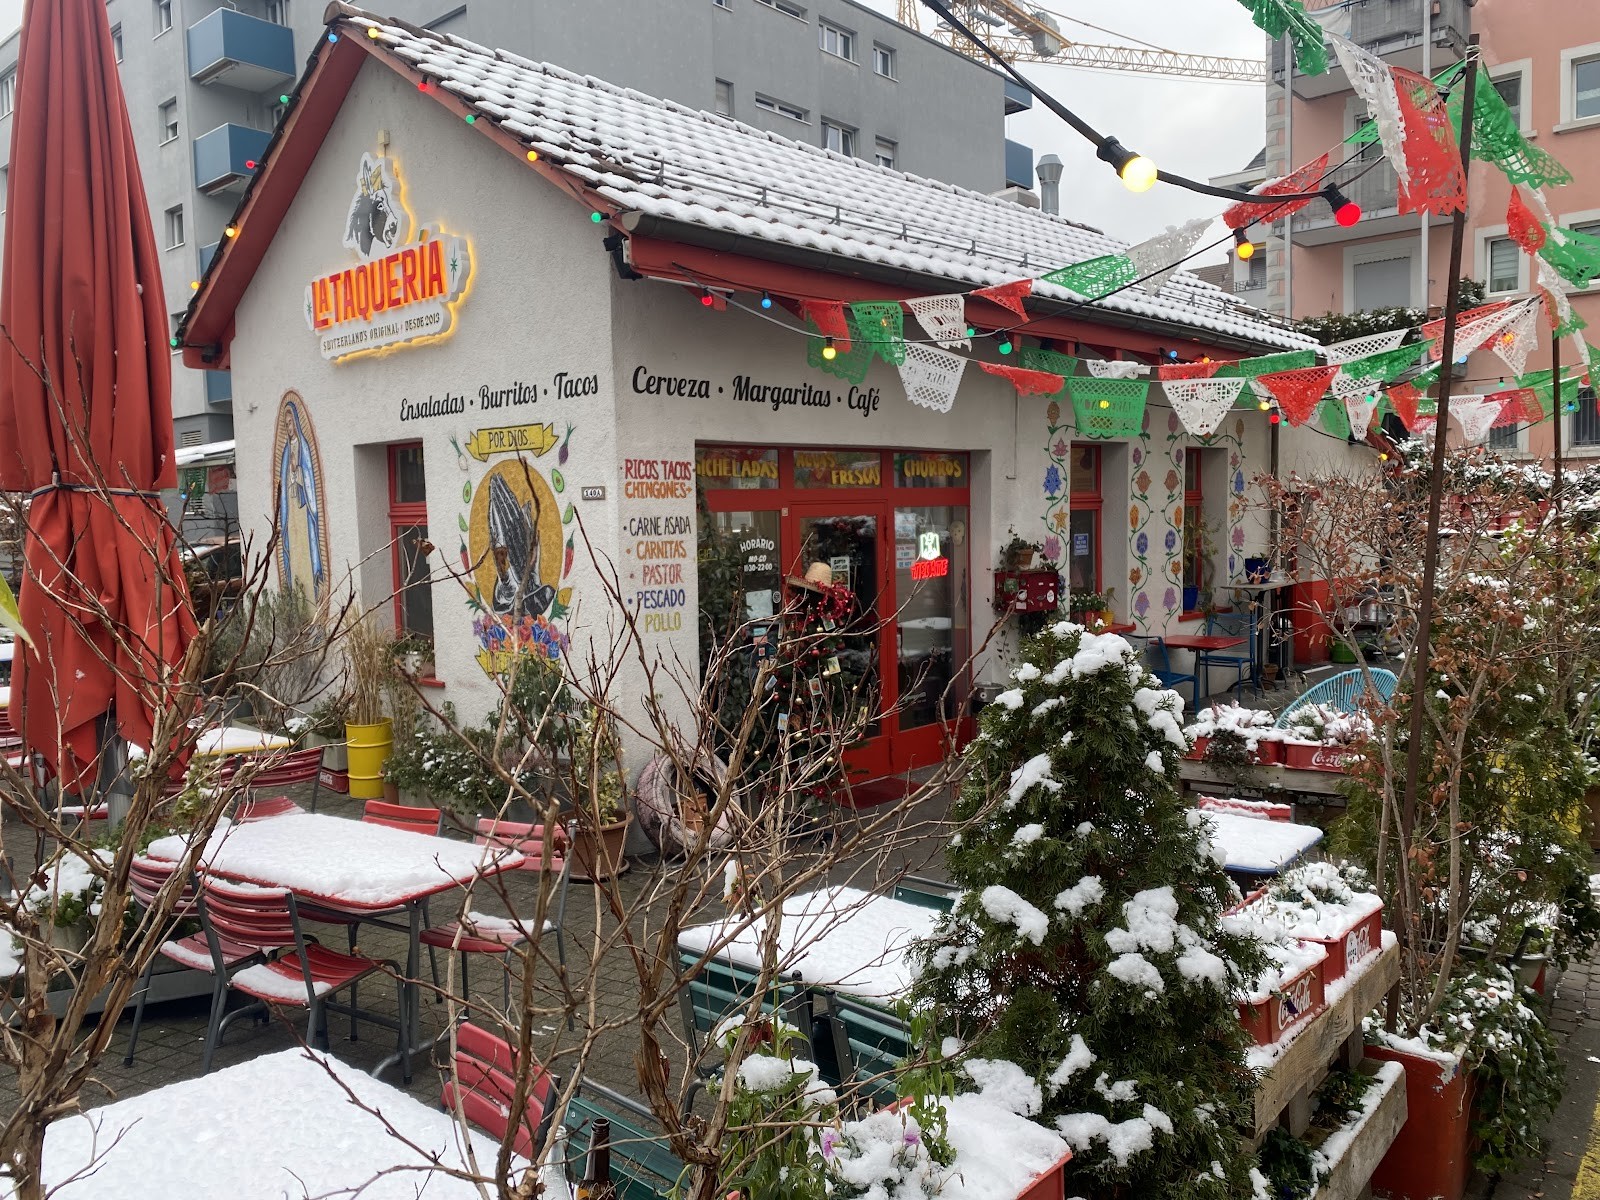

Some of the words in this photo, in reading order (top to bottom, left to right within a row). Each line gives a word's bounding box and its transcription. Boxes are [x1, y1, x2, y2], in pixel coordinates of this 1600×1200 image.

[311, 277, 331, 329] LA
[329, 229, 445, 322] TAQUERÍA
[322, 331, 368, 351] SWITZERLAND'S
[369, 322, 399, 340] ORIGINAL
[404, 316, 424, 331] DESDE
[425, 312, 440, 326] 2013
[400, 392, 465, 422] Ensaladas
[479, 381, 538, 410] Burritos
[553, 372, 599, 400] Tacos
[632, 365, 710, 398] Cerveza
[733, 375, 831, 411] Margaritas
[847, 386, 881, 417] Café
[488, 430, 504, 449] POR
[624, 459, 659, 480] RICOS
[661, 460, 692, 481] TACOS
[831, 465, 880, 485] FRESCAS
[904, 459, 962, 478] CHURROS
[624, 482, 687, 499] CHINGONES
[629, 517, 663, 537] CARNE
[664, 516, 692, 536] ASADA
[636, 540, 687, 560] CARNITAS
[740, 538, 775, 553] HORARIO
[642, 564, 683, 586] PASTOR
[637, 588, 686, 609] PESCADO
[644, 611, 682, 633] POLLO
